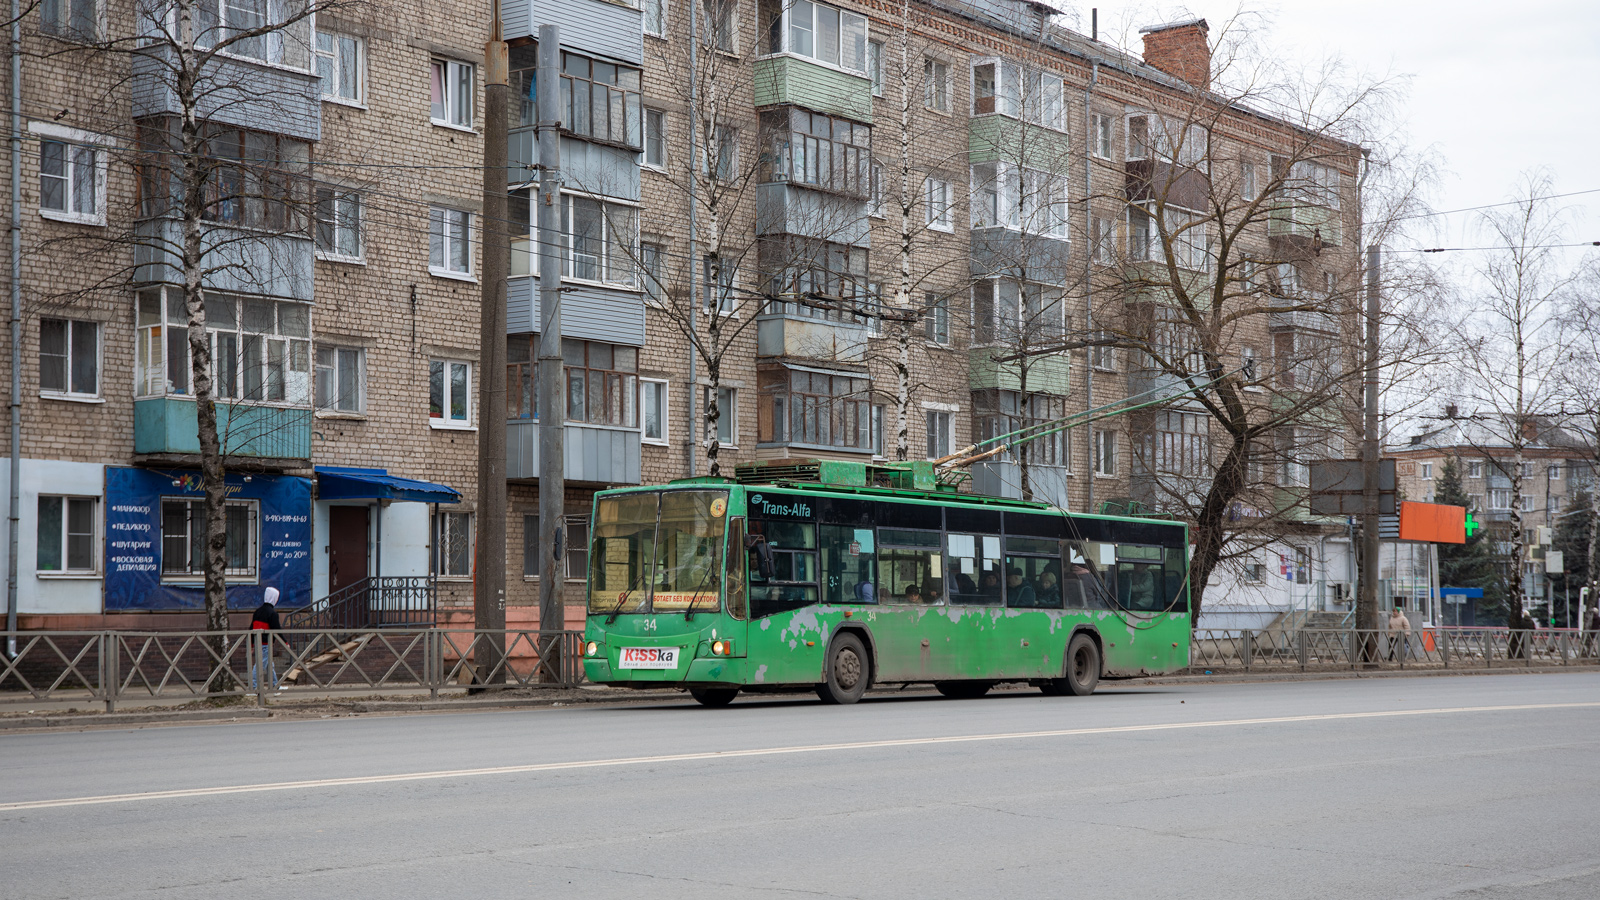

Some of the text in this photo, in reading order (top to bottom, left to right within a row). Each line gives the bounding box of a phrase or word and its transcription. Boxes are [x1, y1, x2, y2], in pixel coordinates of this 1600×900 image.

[116, 505, 151, 515] МАНИКЮР
[762, 500, 811, 518] Trans-Alfa
[116, 522, 151, 533] ПЕДИКЮР
[116, 541, 152, 551] ШУГАРИНГ
[116, 564, 157, 572] ДЕПИЛЯЦИЯ
[867, 611, 877, 622] 34
[643, 618, 657, 631] 34
